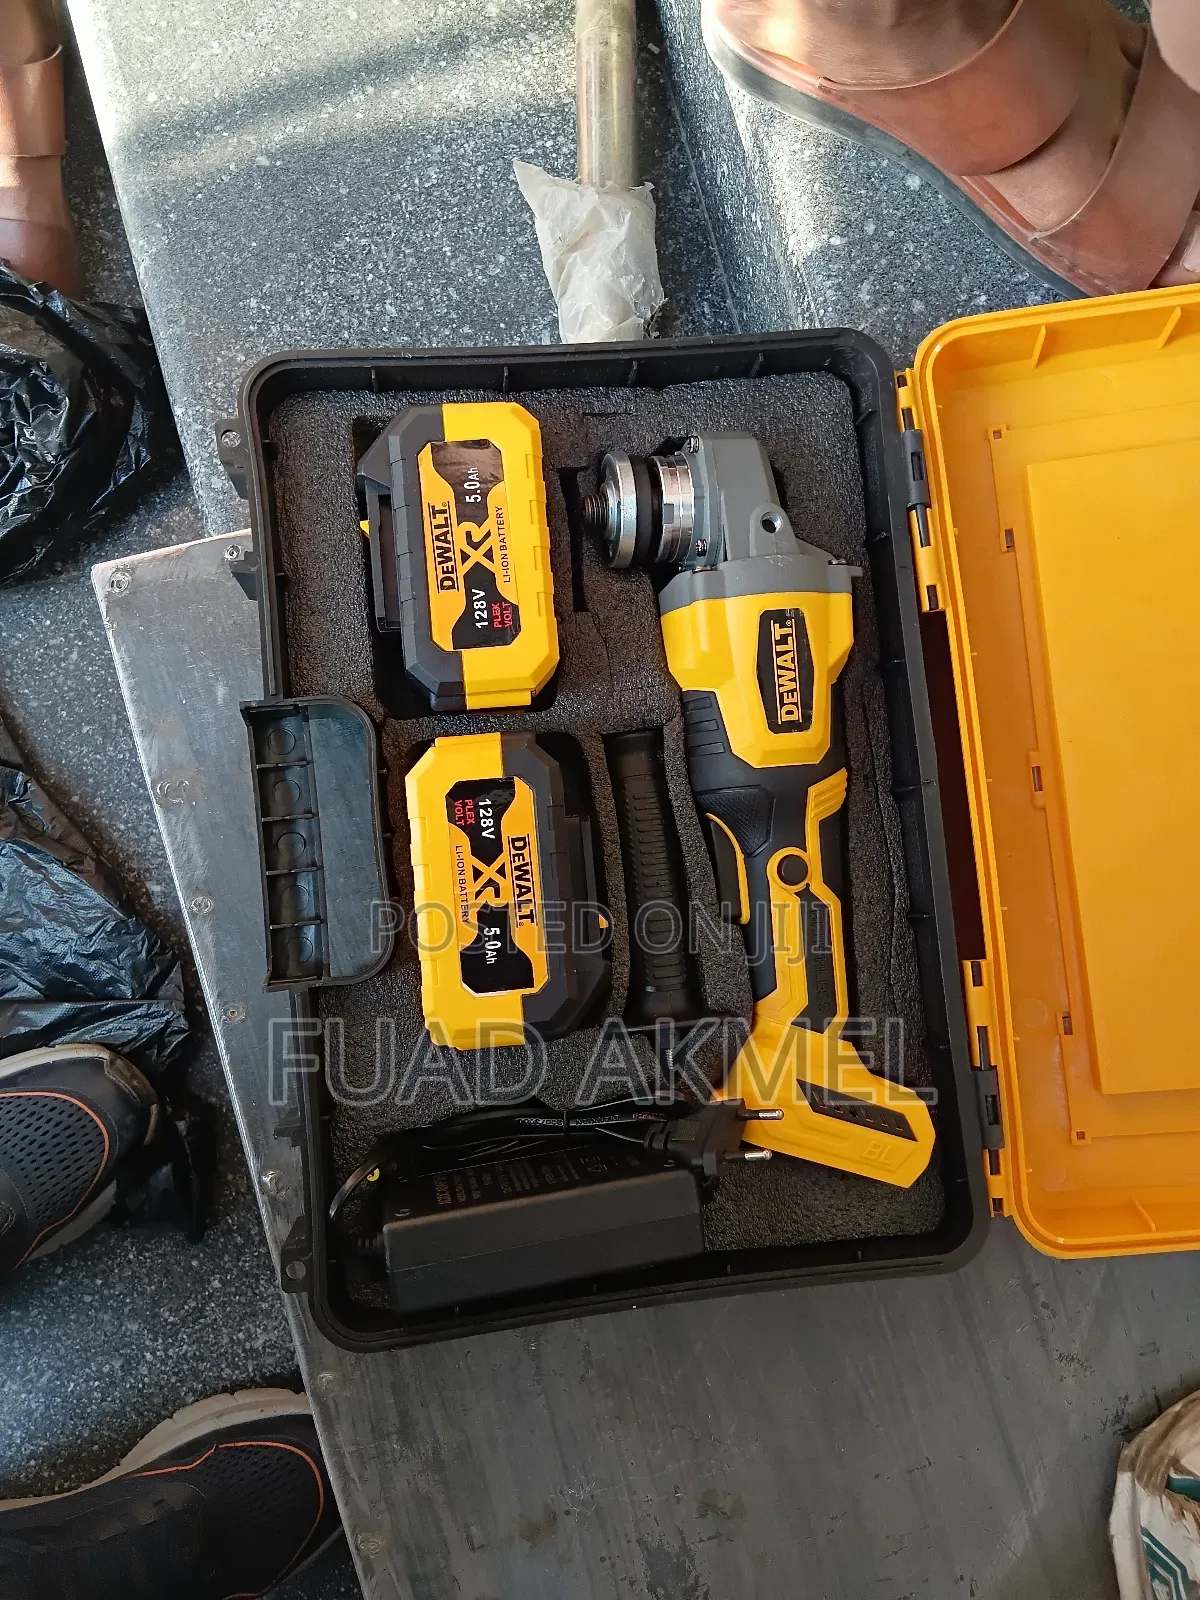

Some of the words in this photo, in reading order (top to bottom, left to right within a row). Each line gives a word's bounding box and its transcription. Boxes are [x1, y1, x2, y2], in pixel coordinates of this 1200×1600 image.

[465, 466, 482, 503] 5.0Ah
[495, 505, 509, 551] BATTERY
[456, 521, 496, 575] XR
[501, 552, 512, 583] LI-ION
[471, 588, 489, 629] 128V
[501, 601, 514, 628] VOLT
[453, 799, 465, 827] VOLT
[464, 799, 476, 825] PLEX
[478, 798, 496, 840] 128V
[454, 845, 466, 876] LI-ION
[470, 851, 509, 908] XR
[458, 878, 471, 925] BATTERY
[483, 926, 502, 965] 5.0Ah
[860, 1140, 893, 1166] BL
